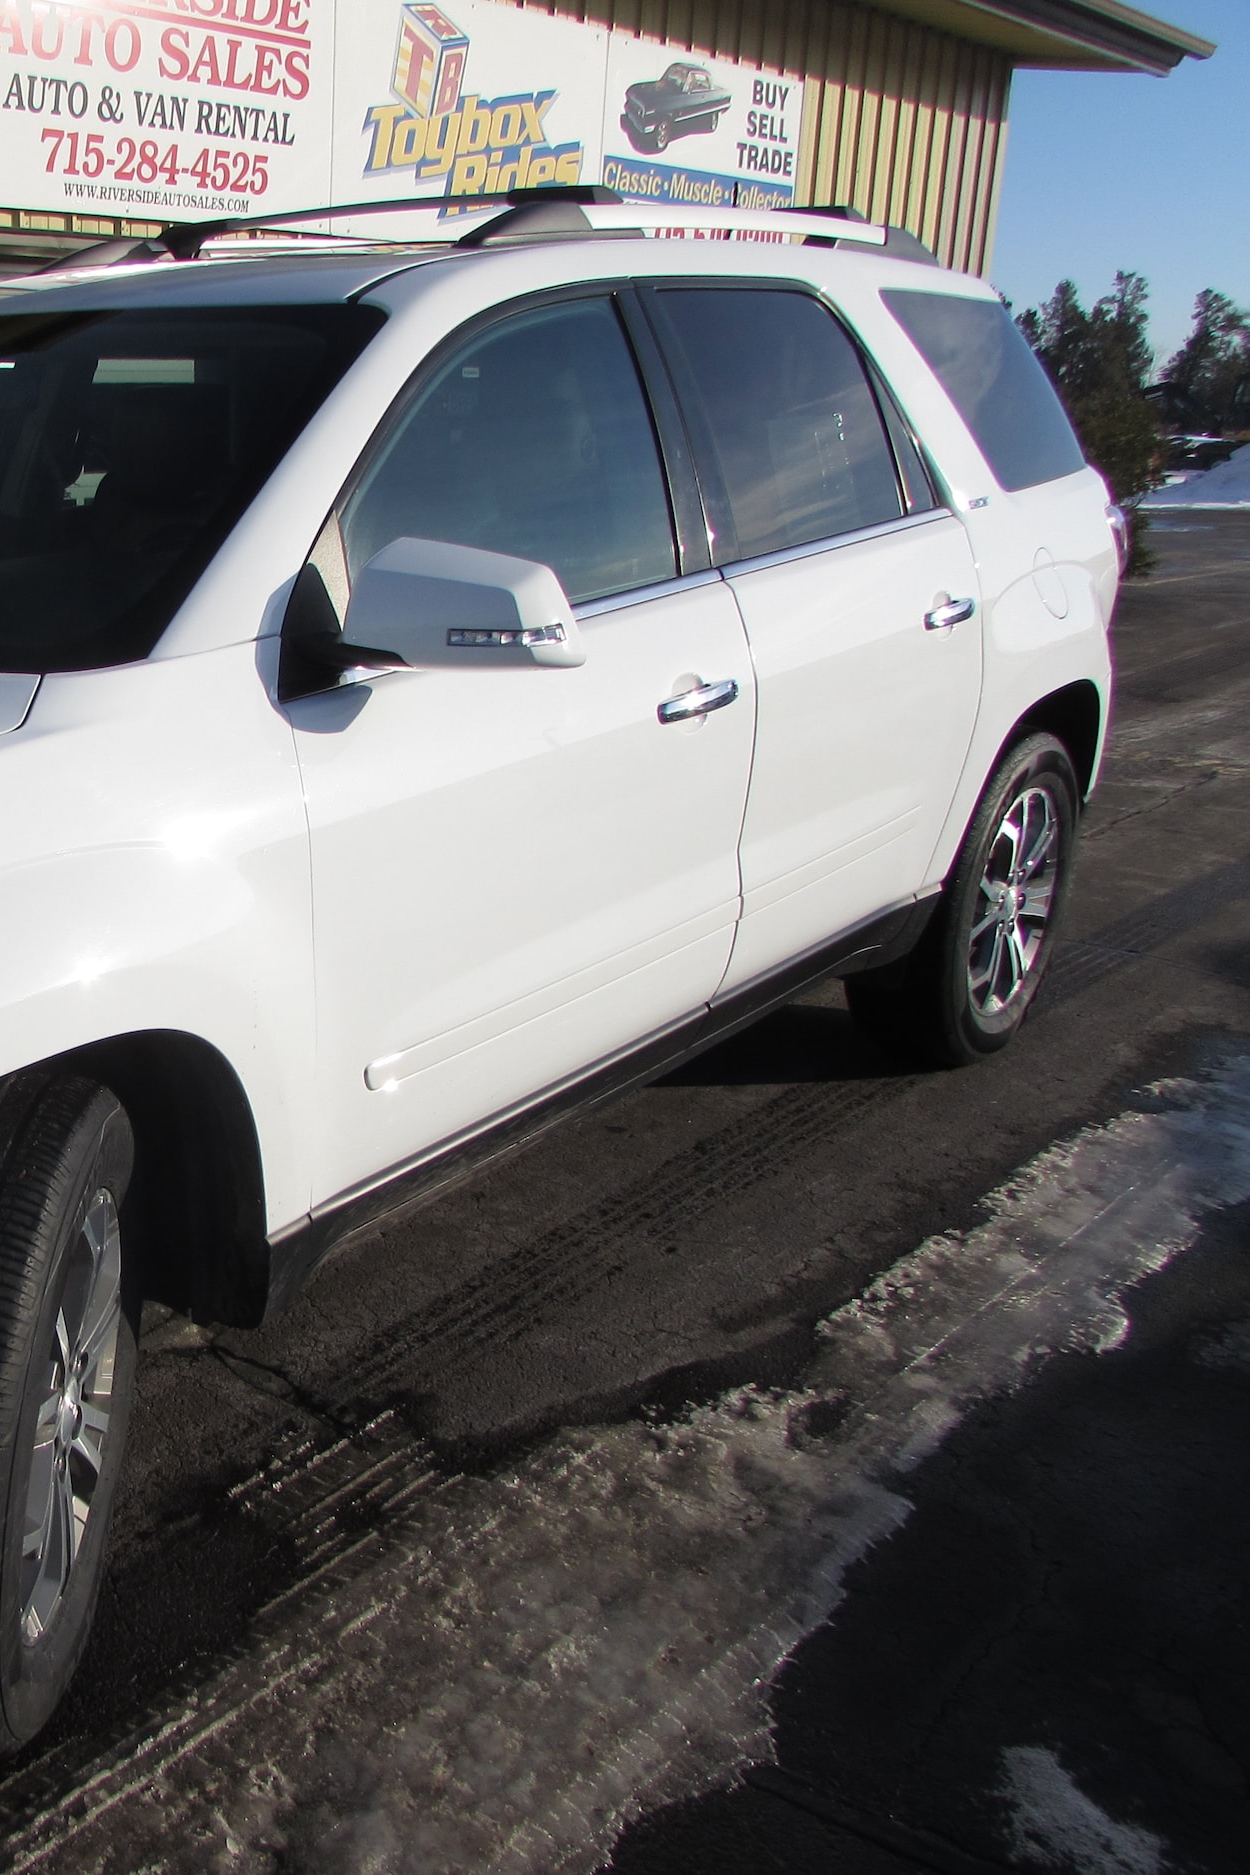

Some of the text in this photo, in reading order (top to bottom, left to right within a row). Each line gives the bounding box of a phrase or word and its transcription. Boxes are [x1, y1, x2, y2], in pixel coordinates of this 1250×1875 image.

[159, 27, 311, 101] SALES
[2, 73, 296, 146] AUTO & VAN RENTAL
[752, 79, 789, 112] BUY
[364, 91, 554, 181] Toybox
[746, 110, 788, 144] SELL
[40, 128, 269, 196] 715-284-4525
[445, 145, 583, 214] Rides
[604, 161, 661, 196] Classic
[669, 173, 723, 206] Muscle
[736, 142, 793, 177] TRADE
[63, 182, 250, 213] WWW.RIVERSIDEAUTOSALES.COM
